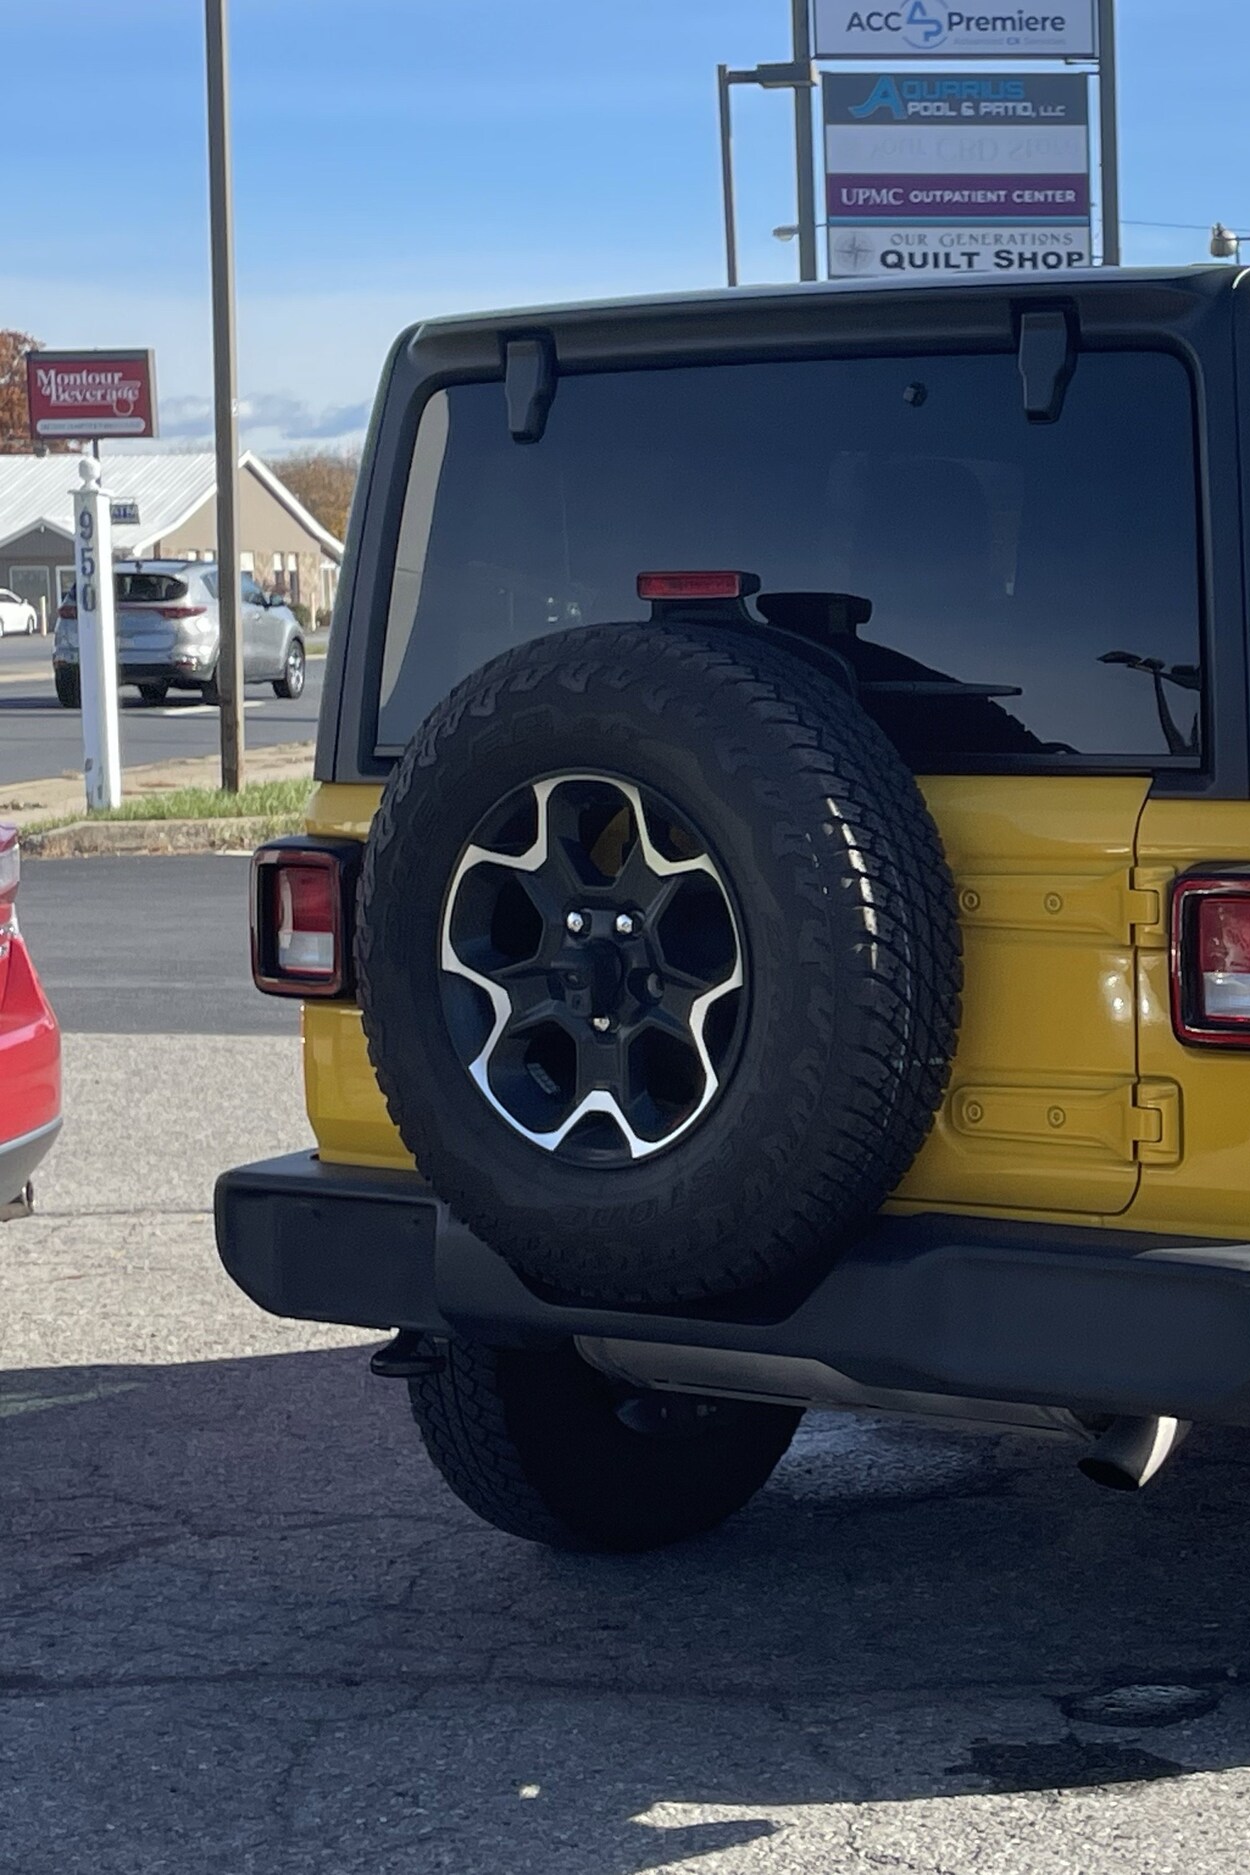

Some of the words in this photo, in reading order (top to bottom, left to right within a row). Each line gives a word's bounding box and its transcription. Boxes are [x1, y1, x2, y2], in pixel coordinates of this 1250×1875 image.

[846, 11, 902, 32] ACC
[947, 9, 1066, 32] Premiere
[907, 101, 957, 117] POOL
[960, 101, 976, 117] &
[978, 102, 1037, 118] PATIO,
[1039, 105, 1066, 117] LLC
[840, 188, 904, 205] UPMC
[909, 190, 1006, 203] OUTPATIENT
[1012, 190, 1076, 203] CENTER
[890, 233, 928, 248] OUR
[938, 232, 1074, 248] GENERATIONS
[880, 249, 981, 270] QUILT
[993, 249, 1085, 269] SHOP
[36, 368, 123, 388] Montour
[80, 510, 97, 612] 950
